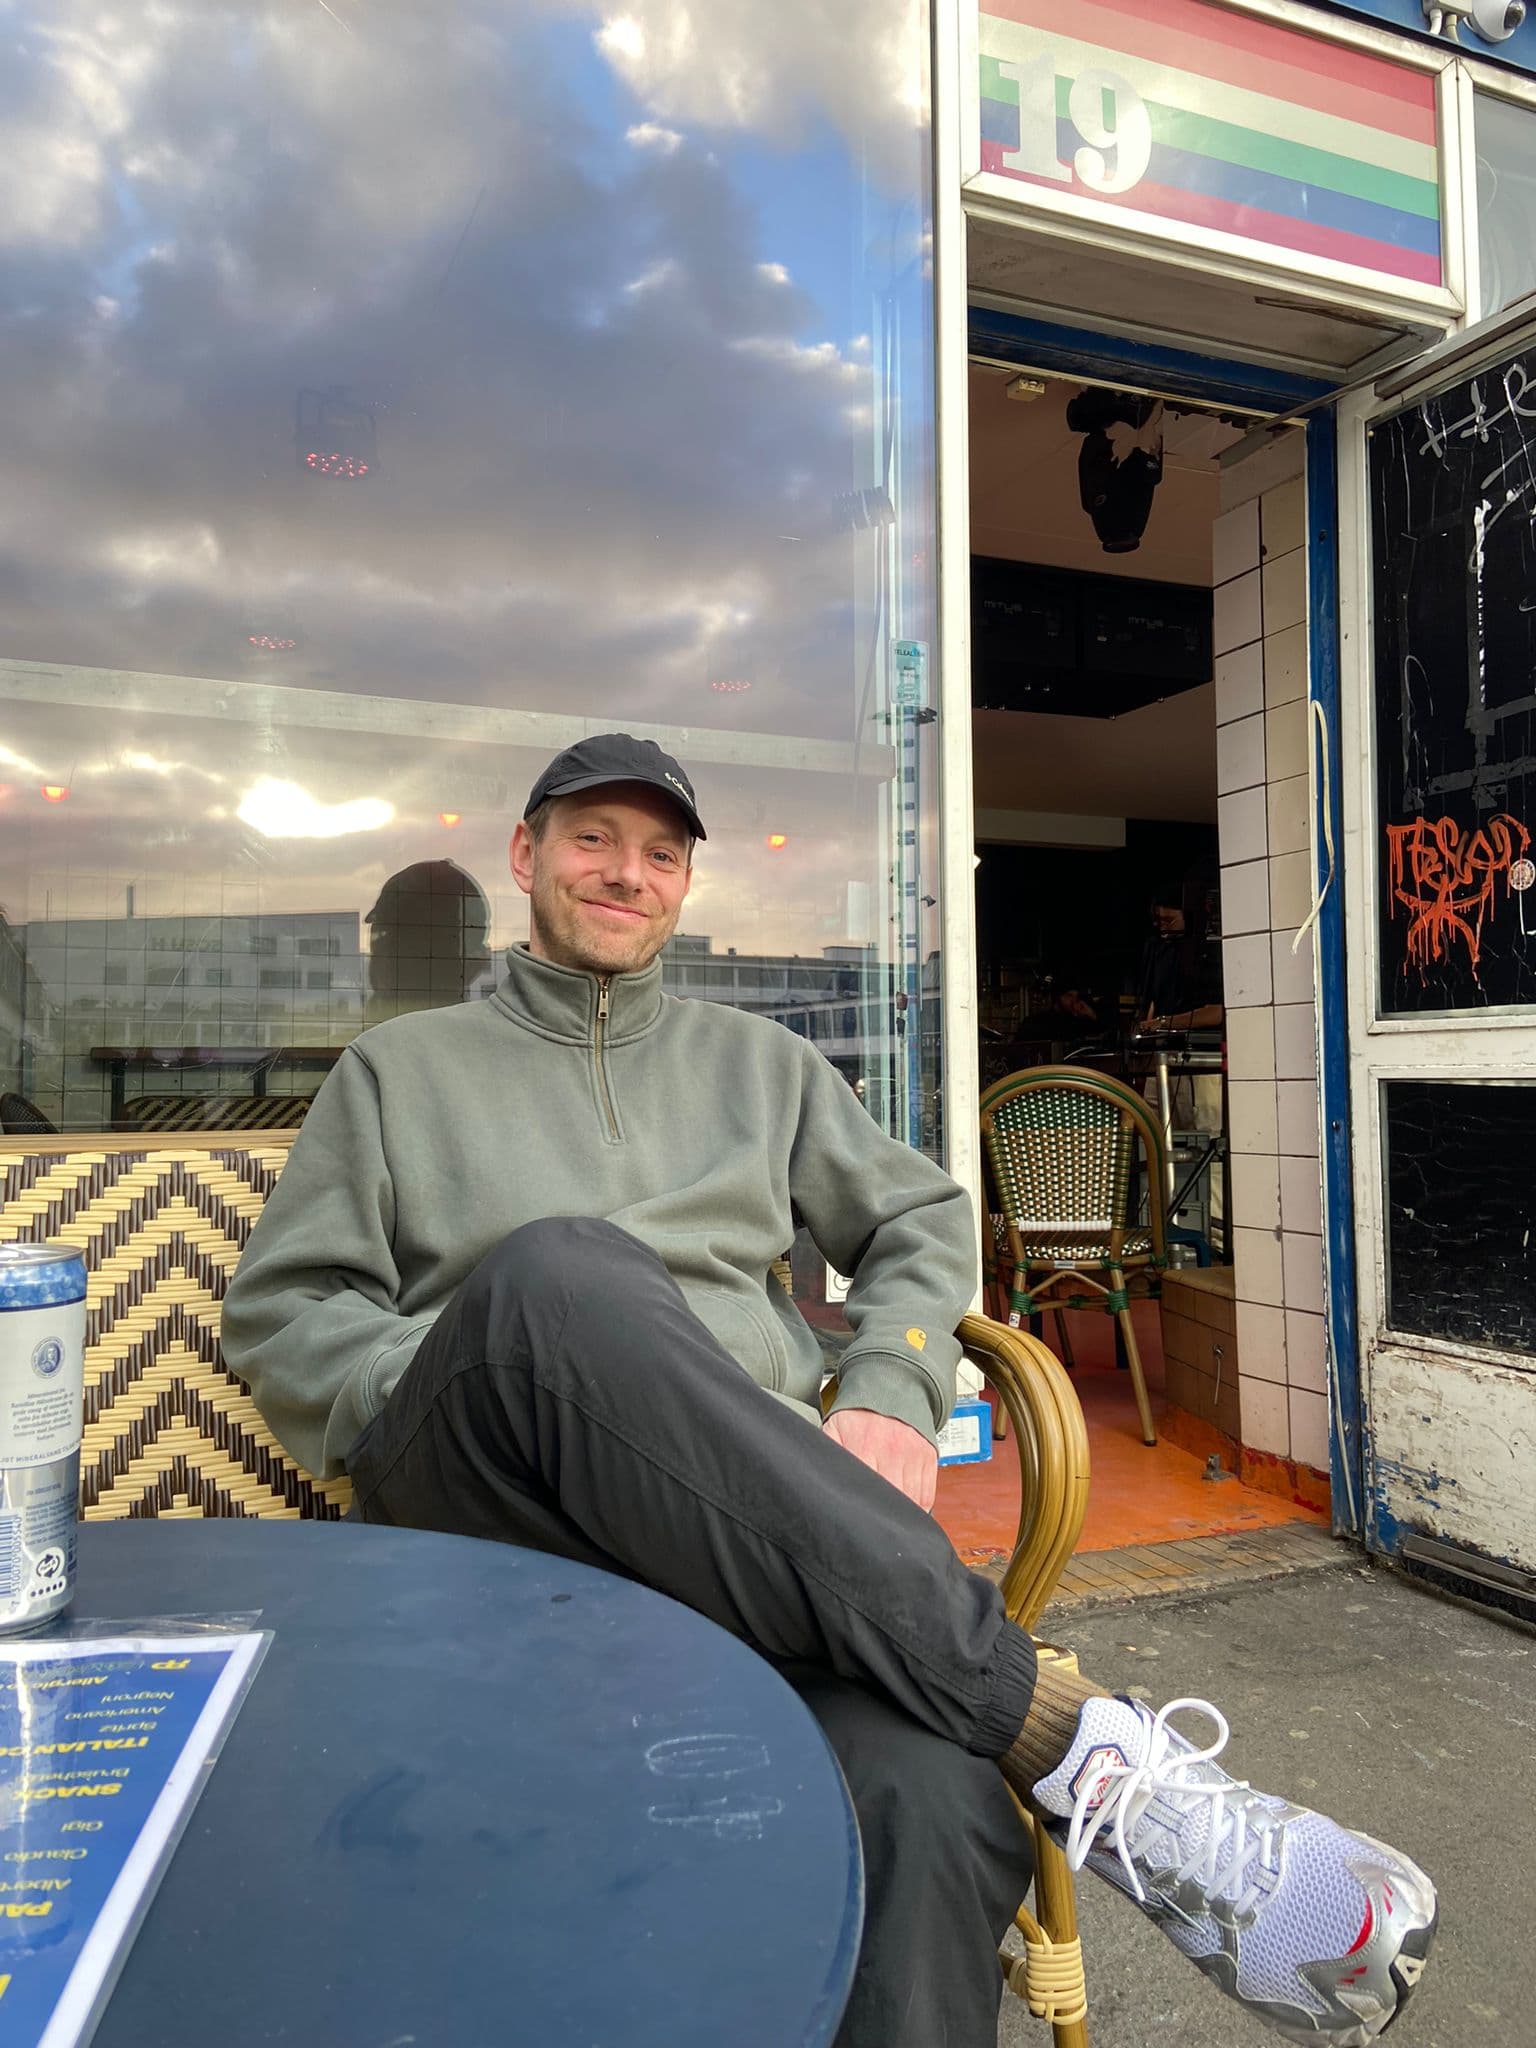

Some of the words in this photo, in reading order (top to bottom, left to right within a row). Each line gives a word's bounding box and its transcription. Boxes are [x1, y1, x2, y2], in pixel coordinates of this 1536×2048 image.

[999, 54, 1153, 194] 19
[101, 1691, 174, 1705] Negroni
[64, 1706, 166, 1721] Americano
[98, 1720, 157, 1734] Spritz
[34, 1736, 150, 1756] ITALIAN
[13, 1783, 122, 1800] SNACK
[61, 1820, 103, 1834] Gigi
[4, 1848, 88, 1863] Claudio
